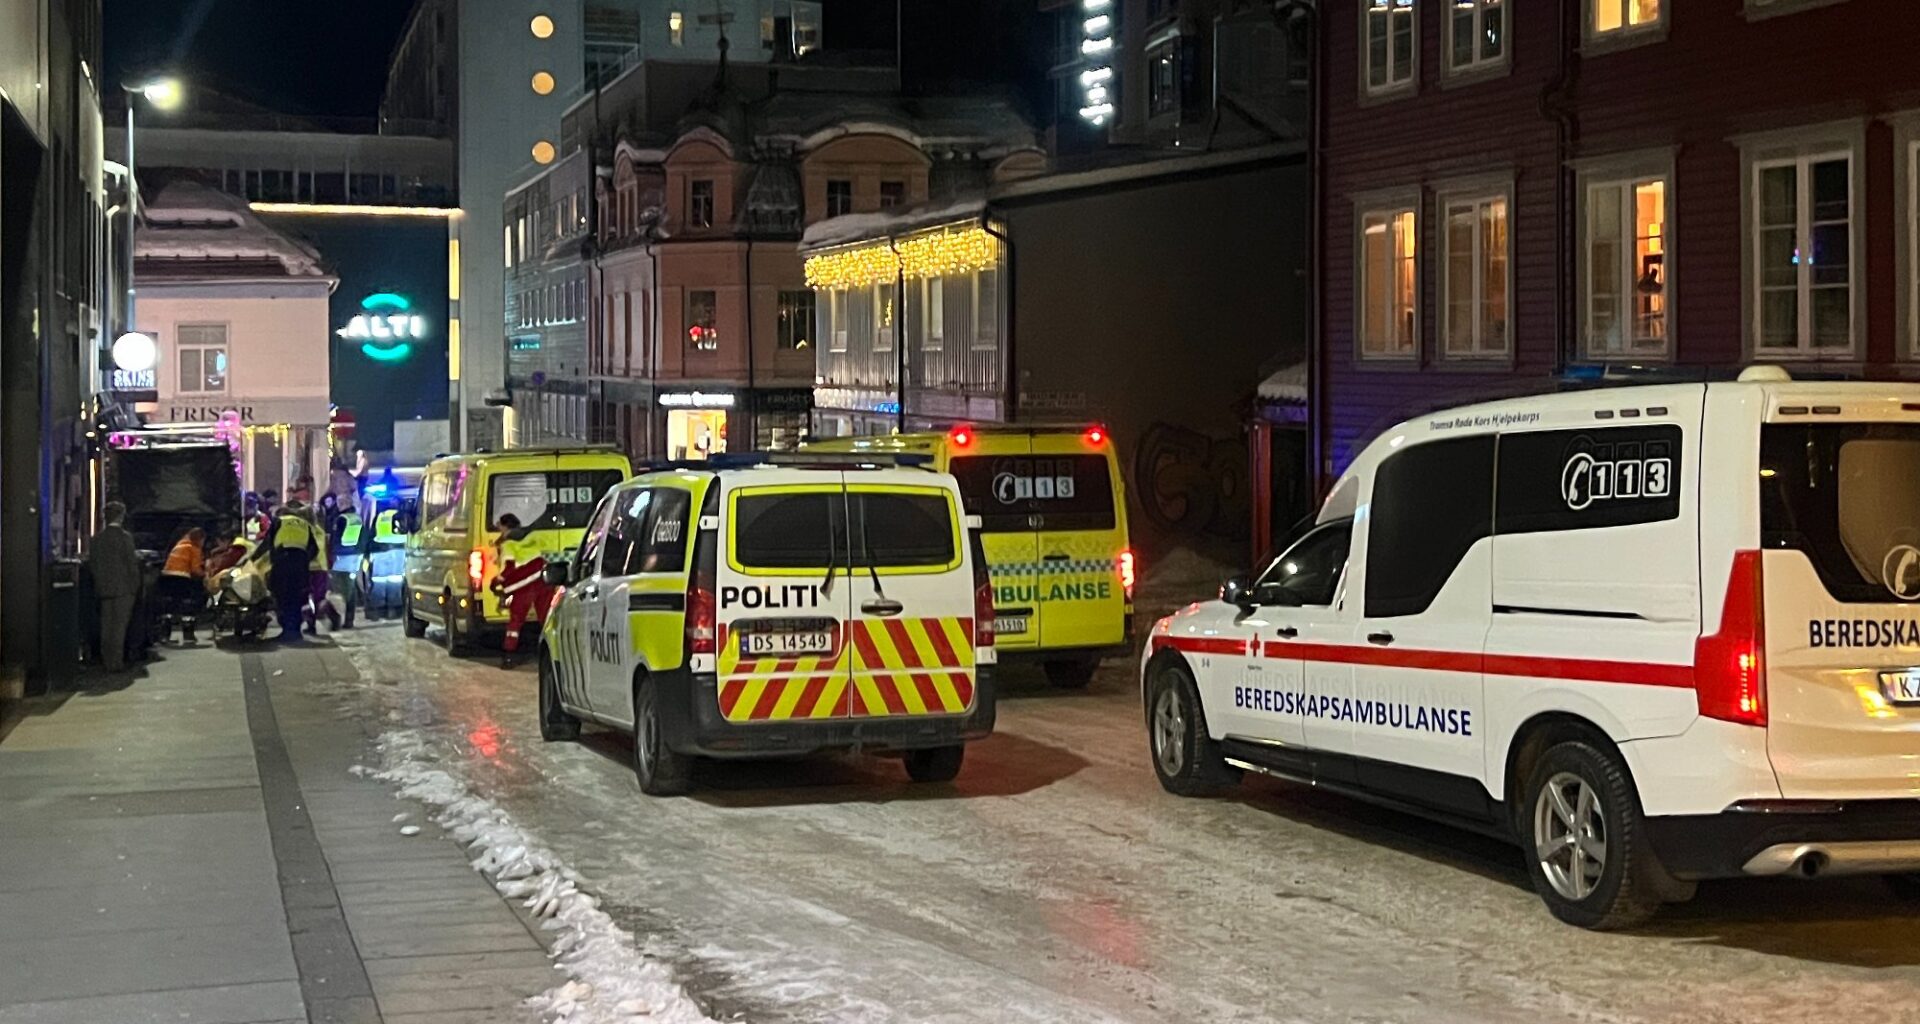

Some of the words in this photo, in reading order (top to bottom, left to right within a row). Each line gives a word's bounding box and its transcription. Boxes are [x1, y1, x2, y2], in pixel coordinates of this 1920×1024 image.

[340, 314, 427, 338] ALTI
[1019, 478, 1072, 497] 113
[1596, 462, 1666, 495] 113
[720, 584, 818, 610] POLITI
[590, 630, 621, 666] POLITI
[753, 635, 774, 651] DS
[780, 634, 827, 651] 14549
[1234, 685, 1473, 737] BEREDSKAPSAMBULANSE
